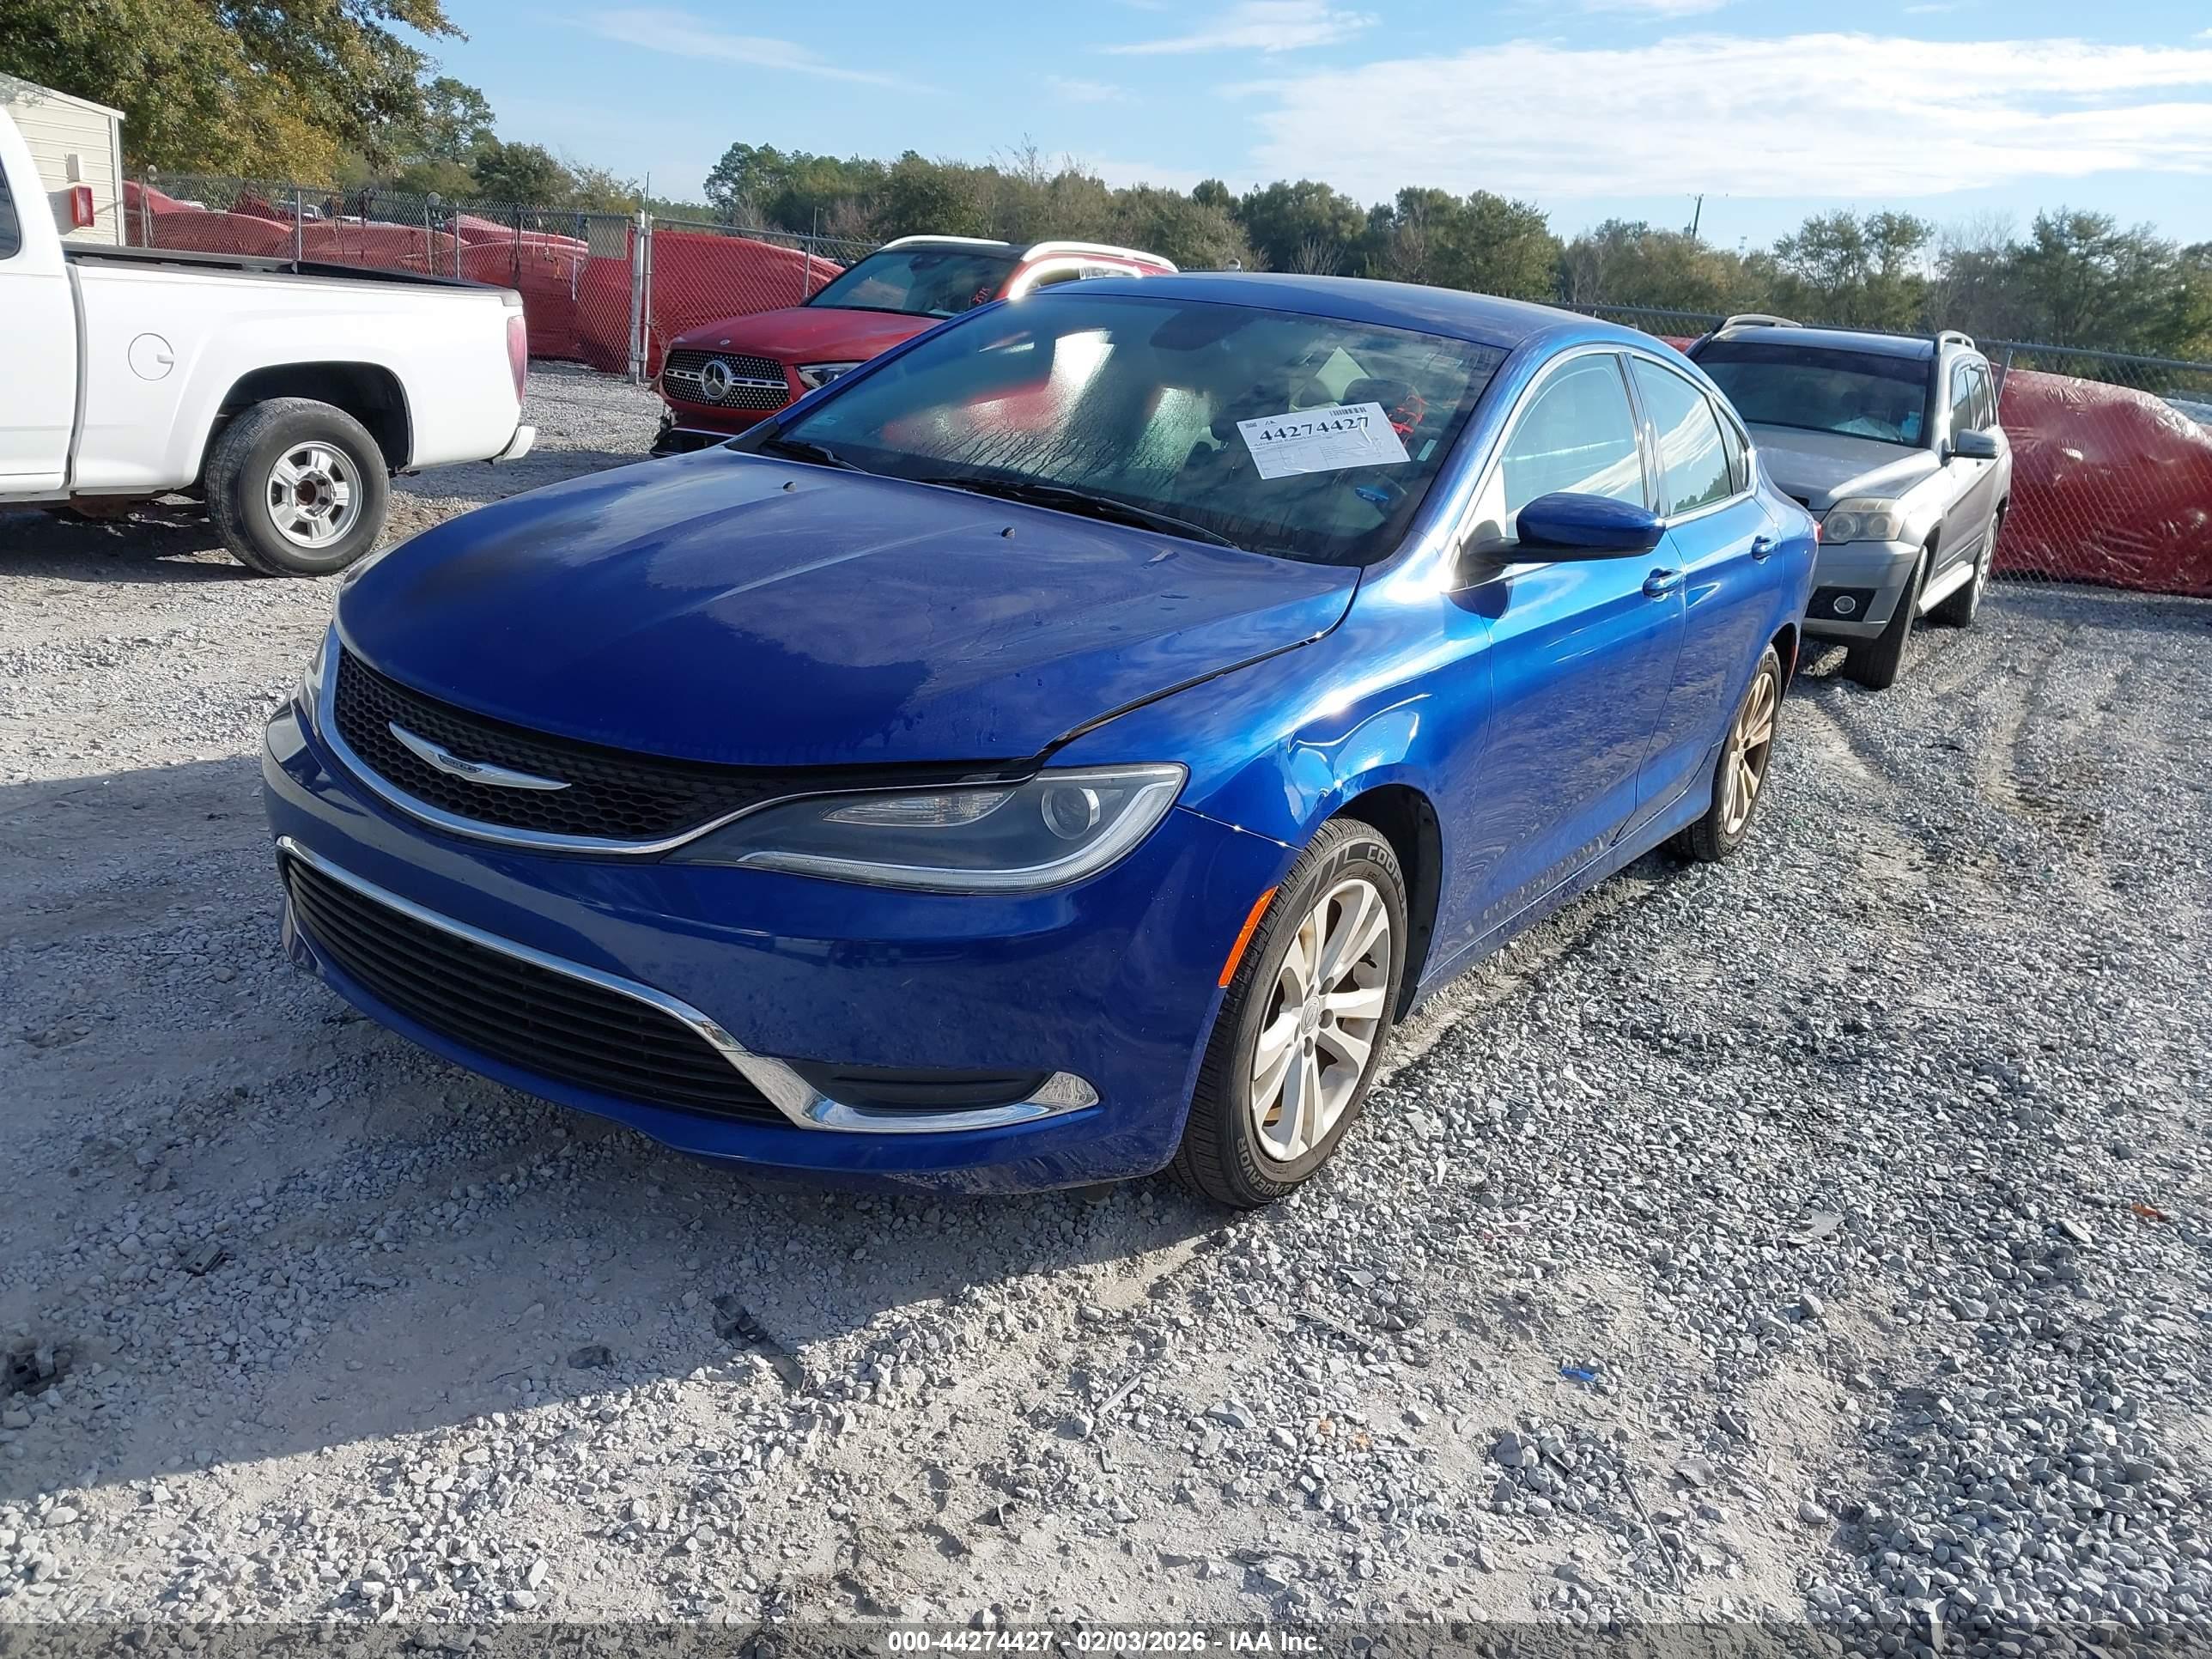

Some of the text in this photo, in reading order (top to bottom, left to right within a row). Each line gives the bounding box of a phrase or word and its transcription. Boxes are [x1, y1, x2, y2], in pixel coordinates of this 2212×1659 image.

[1260, 416, 1369, 441] 44274427
[1367, 845, 1407, 920] COOPER
[1237, 1136, 1293, 1197] ENDEAVOR
